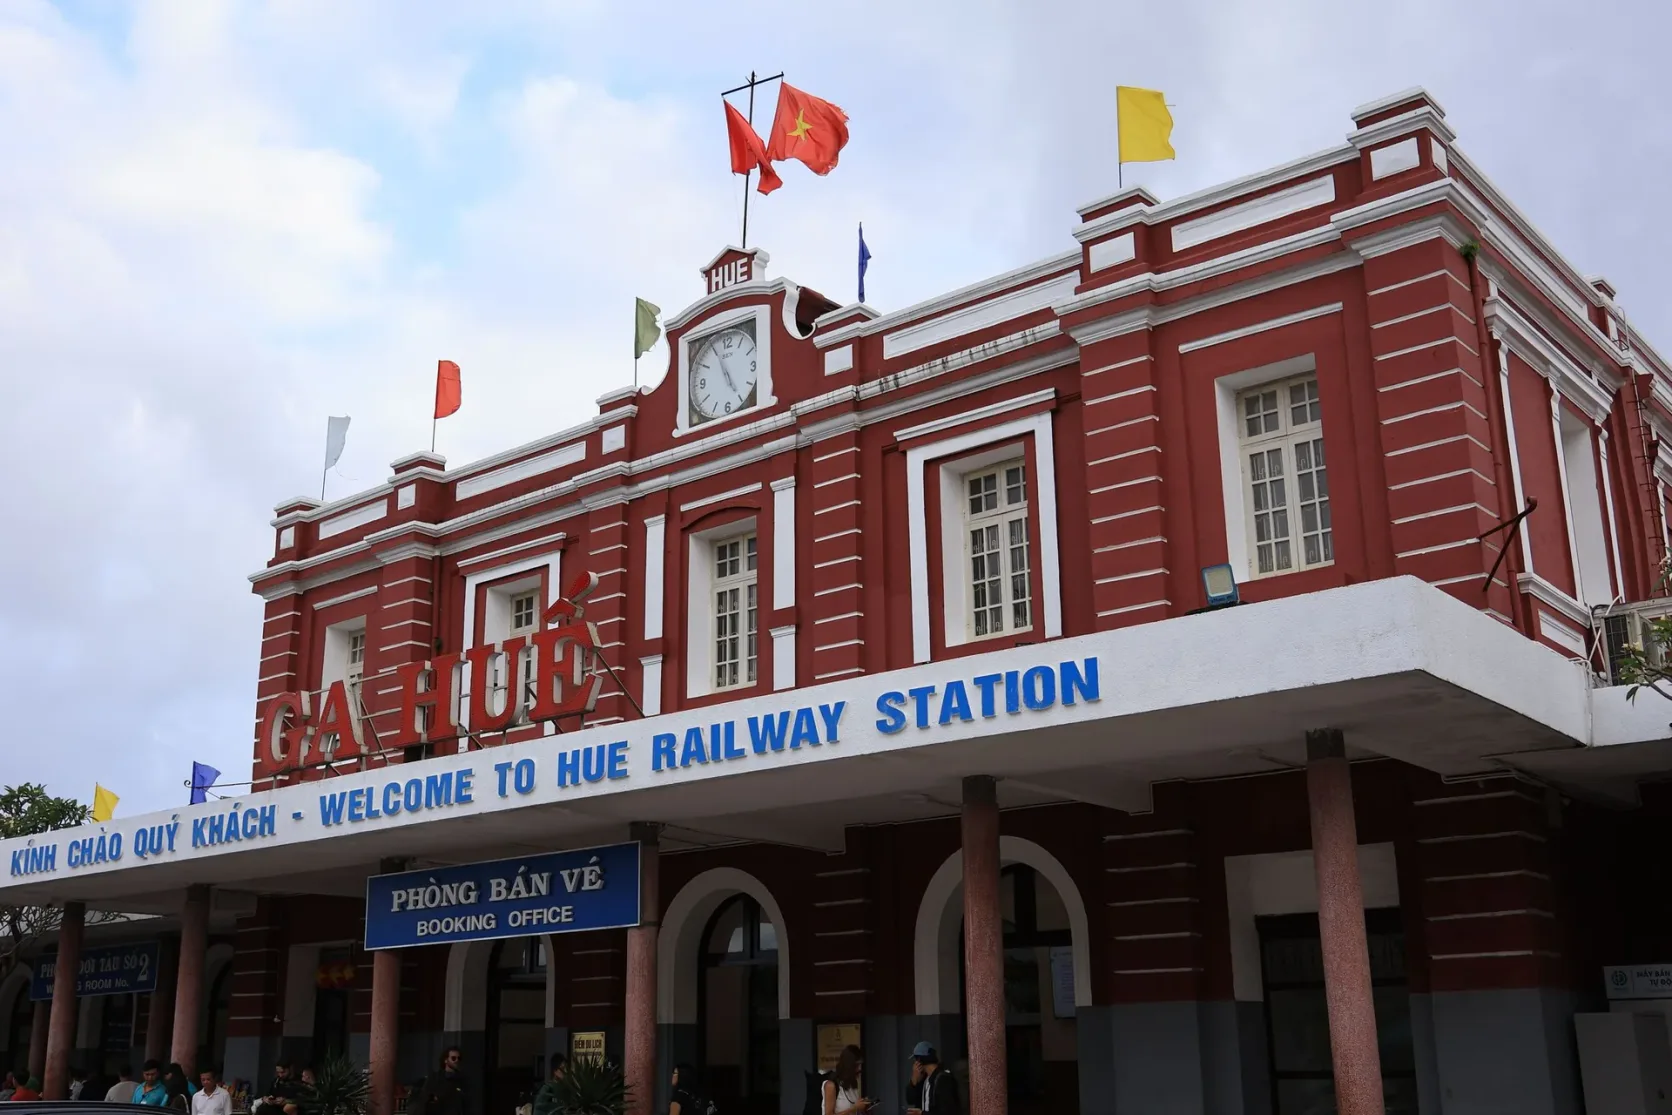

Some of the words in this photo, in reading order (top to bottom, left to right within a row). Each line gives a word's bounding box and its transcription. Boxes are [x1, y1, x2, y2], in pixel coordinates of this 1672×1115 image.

[711, 257, 748, 292] HUE
[722, 337, 733, 350] 12
[750, 360, 757, 372] 3
[699, 378, 706, 389] 9
[724, 402, 731, 413] 6
[261, 680, 368, 776] GA
[396, 571, 603, 748] HUẾ
[10, 837, 57, 876] KÍNH
[67, 826, 122, 868] CHÀO
[134, 814, 180, 859] QUÝ
[192, 802, 276, 847] KHÁCH
[319, 768, 474, 827] WELCOME
[494, 758, 536, 798] TO
[557, 741, 629, 787] HUE
[652, 701, 846, 772] RAILWAY
[875, 657, 1100, 735] STATION
[391, 877, 478, 912] PHÒNG
[489, 865, 550, 902] BÁN
[560, 856, 604, 892] VÉ
[417, 913, 496, 937] BOOKING
[508, 905, 573, 928] OFFICE
[137, 953, 150, 981] 2
[85, 978, 112, 992] ROOM
